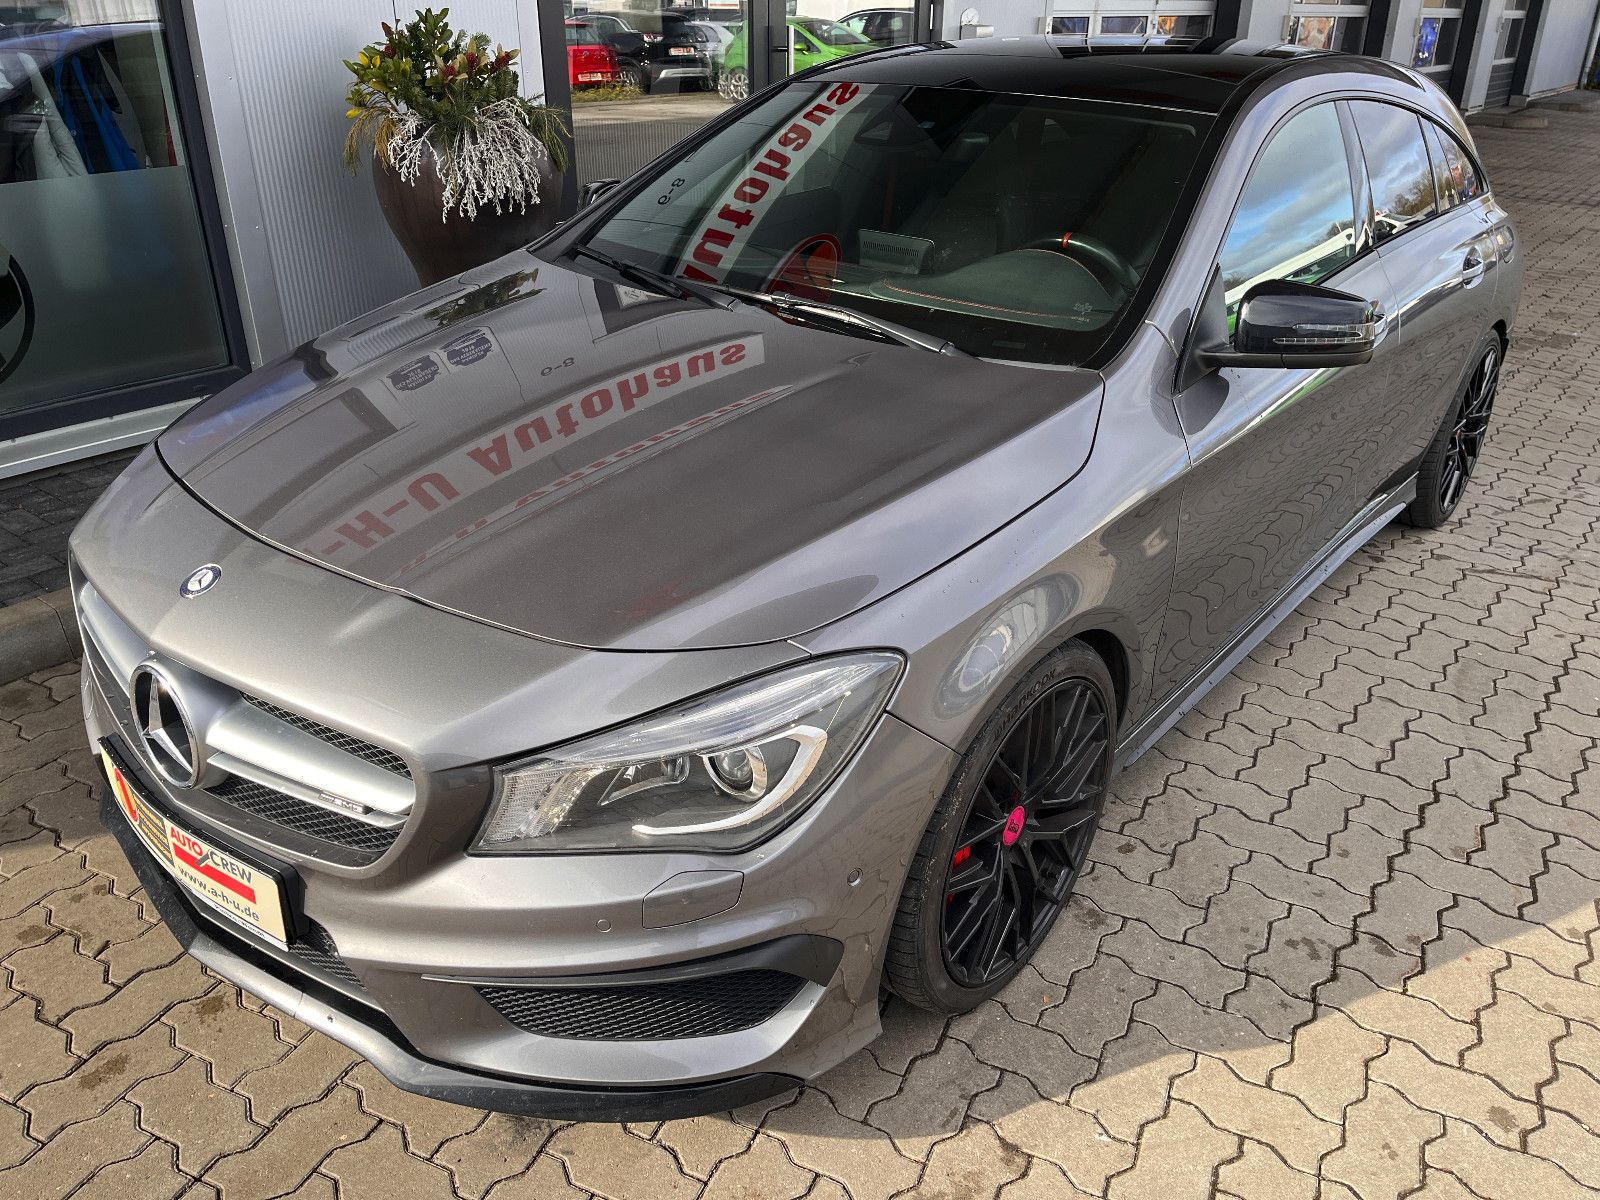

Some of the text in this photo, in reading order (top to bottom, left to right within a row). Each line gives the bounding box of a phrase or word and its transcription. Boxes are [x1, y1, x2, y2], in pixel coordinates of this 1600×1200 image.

[170, 826, 203, 857] AUTO
[209, 850, 252, 884] CREW
[178, 866, 260, 921] www.a-h-u.de
